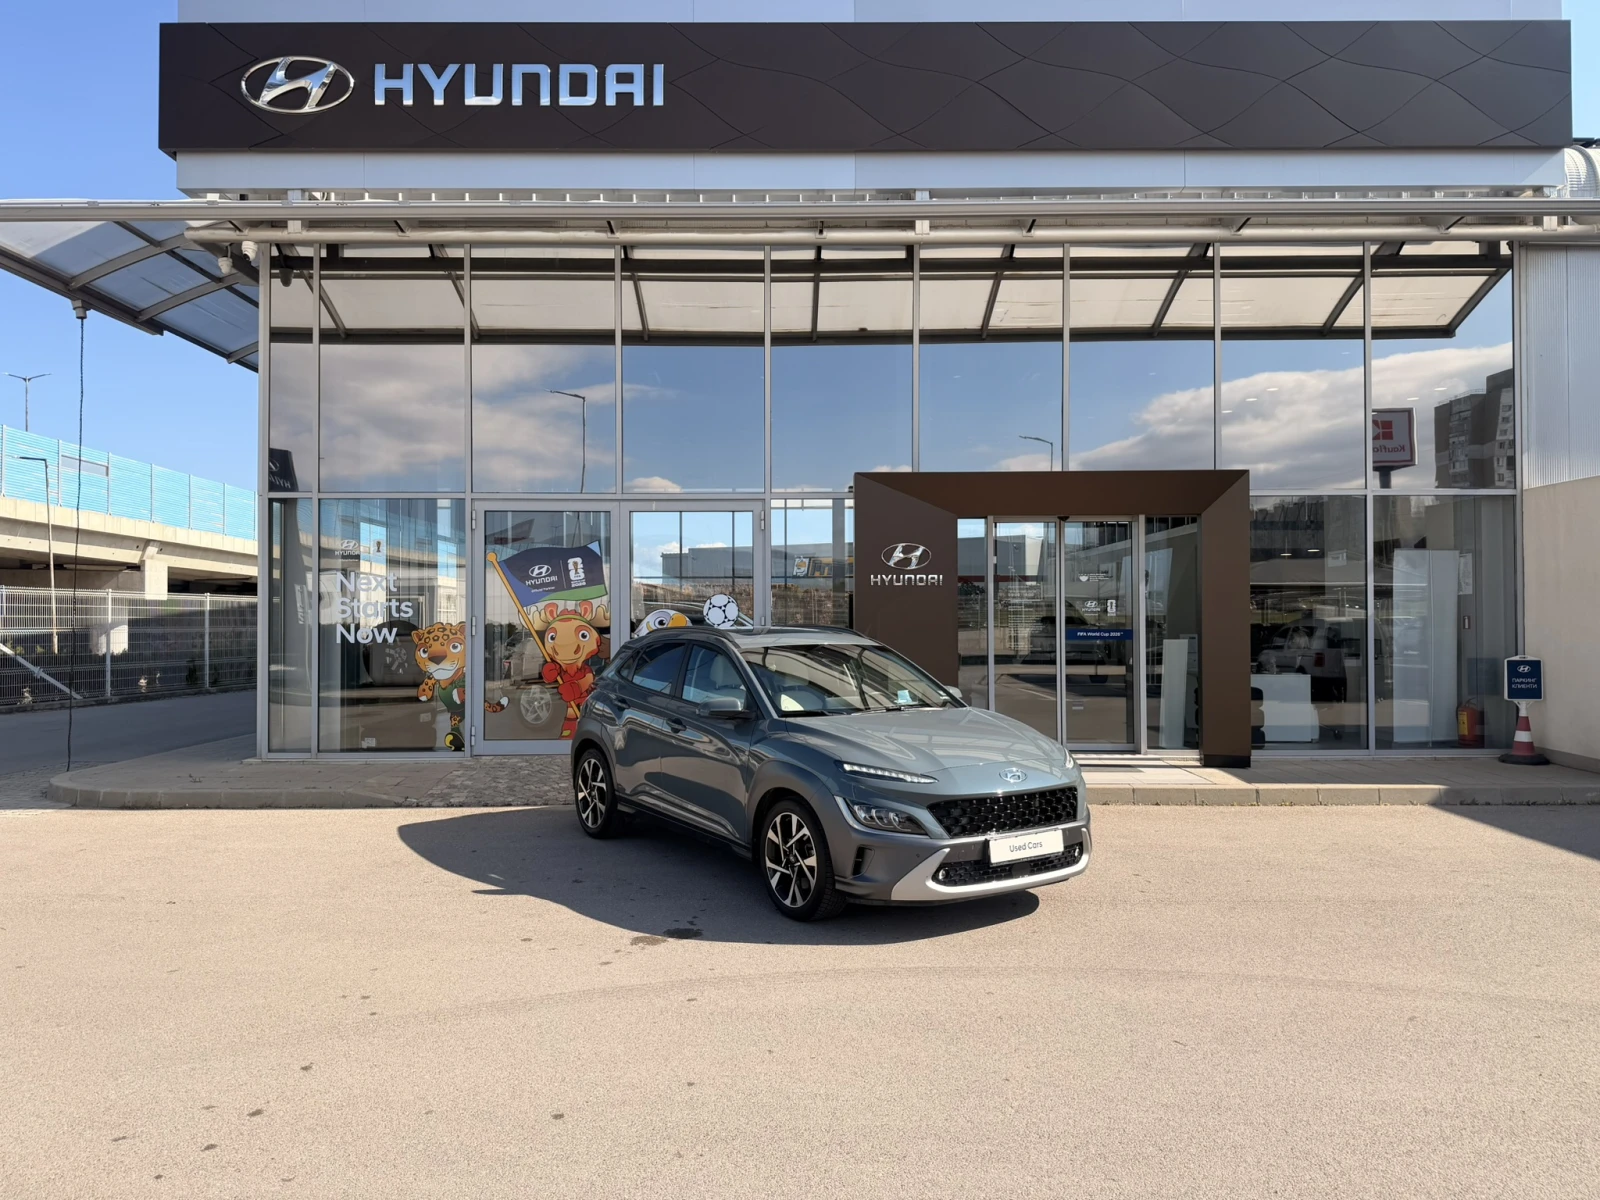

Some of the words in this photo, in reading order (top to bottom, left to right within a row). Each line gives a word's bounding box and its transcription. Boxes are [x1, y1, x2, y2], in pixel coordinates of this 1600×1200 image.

[374, 63, 664, 106] HYUNDAI
[336, 571, 398, 592] Next
[525, 575, 558, 586] HYUNDAI
[870, 574, 943, 586] HYUNDAI
[337, 597, 414, 618] Starts
[336, 623, 398, 644] Now
[1009, 843, 1027, 852] Used
[1027, 841, 1043, 850] Cars
